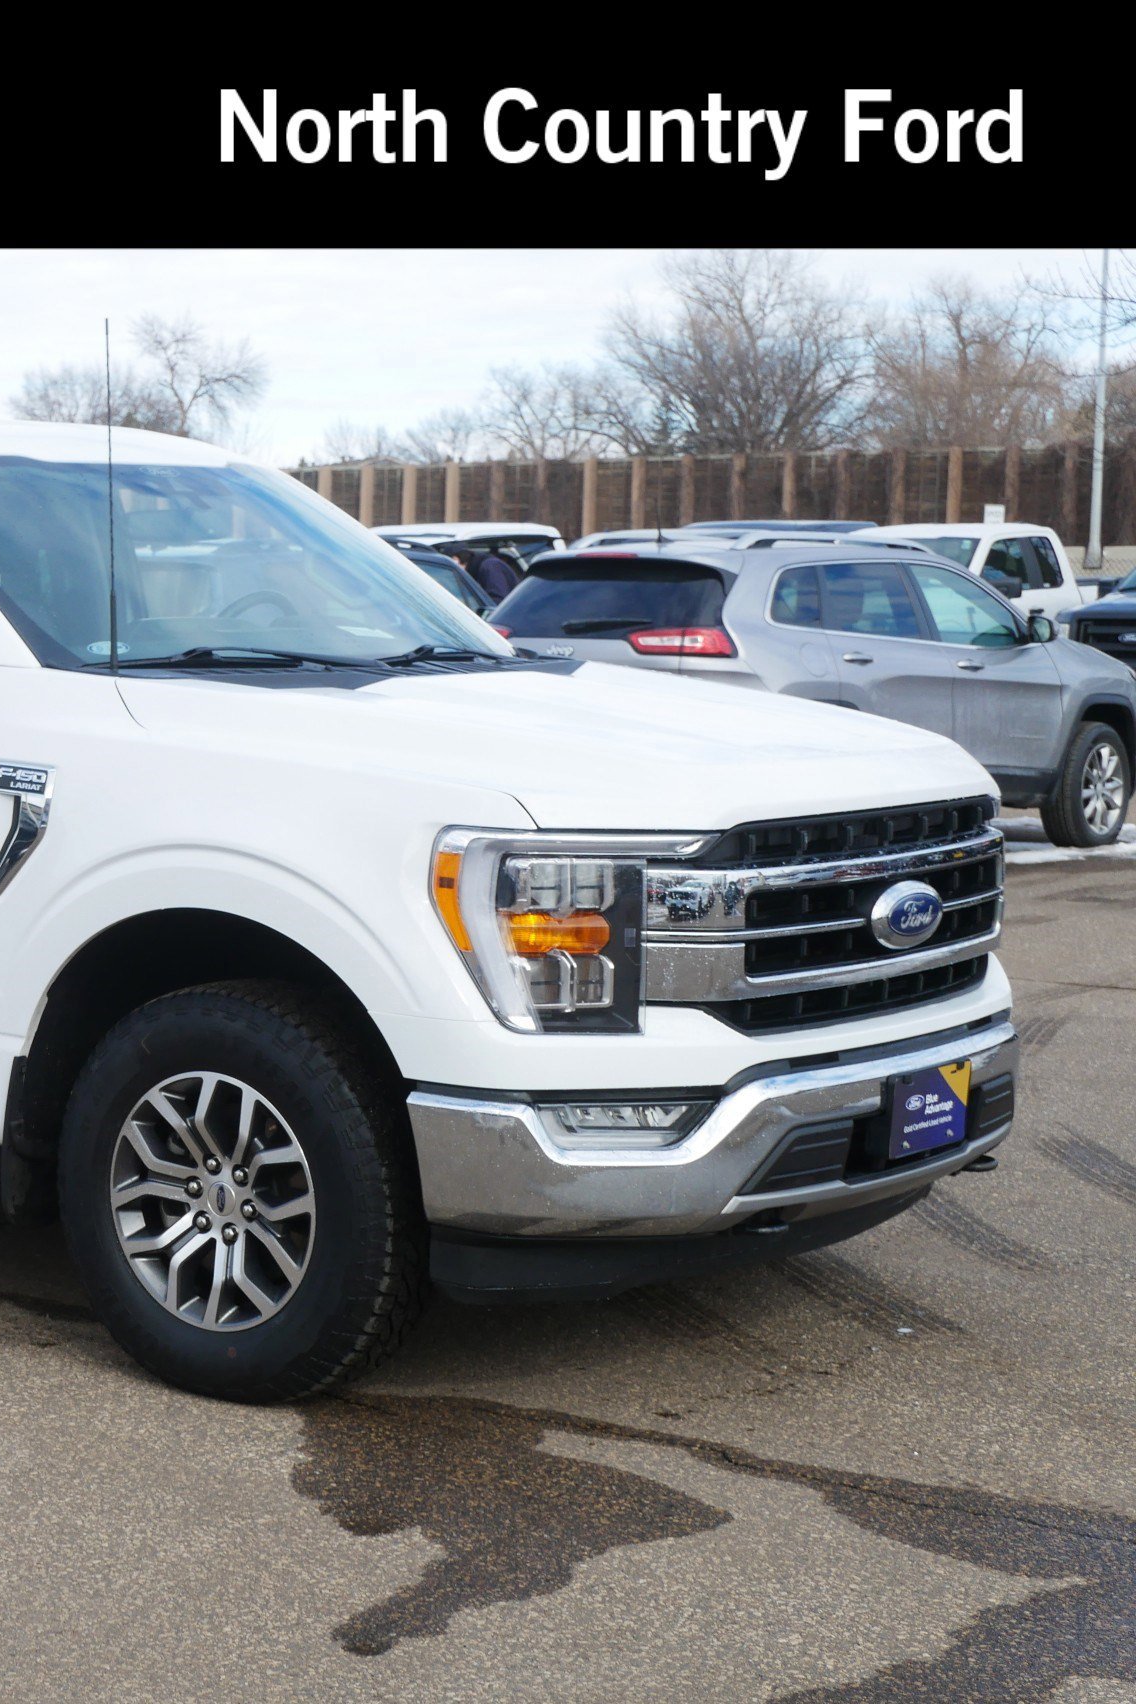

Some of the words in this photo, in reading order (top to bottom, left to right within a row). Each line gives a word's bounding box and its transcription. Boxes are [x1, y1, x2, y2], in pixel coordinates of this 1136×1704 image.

[10, 781, 42, 791] LARIAT
[900, 900, 933, 929] Ford
[925, 1093, 938, 1104] Blue
[924, 1100, 954, 1115] Advantage
